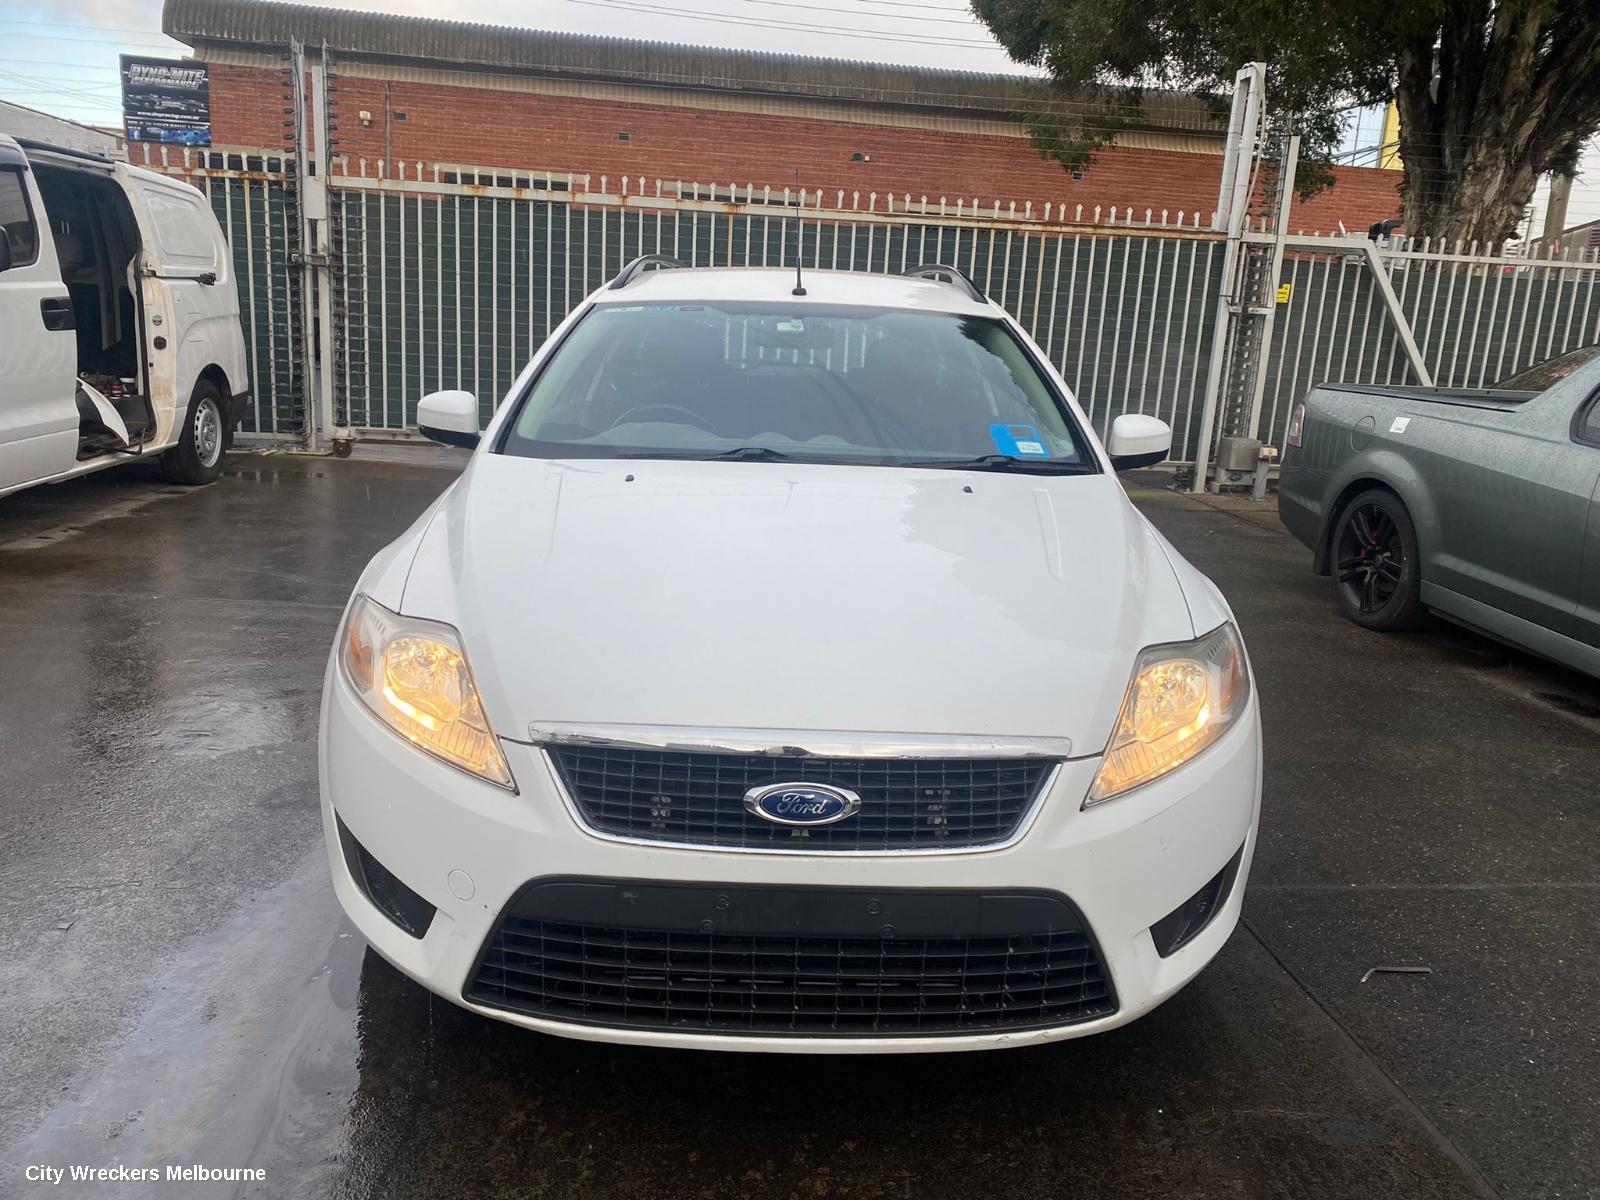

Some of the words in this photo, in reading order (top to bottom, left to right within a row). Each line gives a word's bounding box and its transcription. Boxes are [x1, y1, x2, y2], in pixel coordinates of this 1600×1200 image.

[132, 66, 203, 81] DYNO-MITE
[134, 76, 196, 87] PERFORMANCE
[777, 792, 828, 815] Ford
